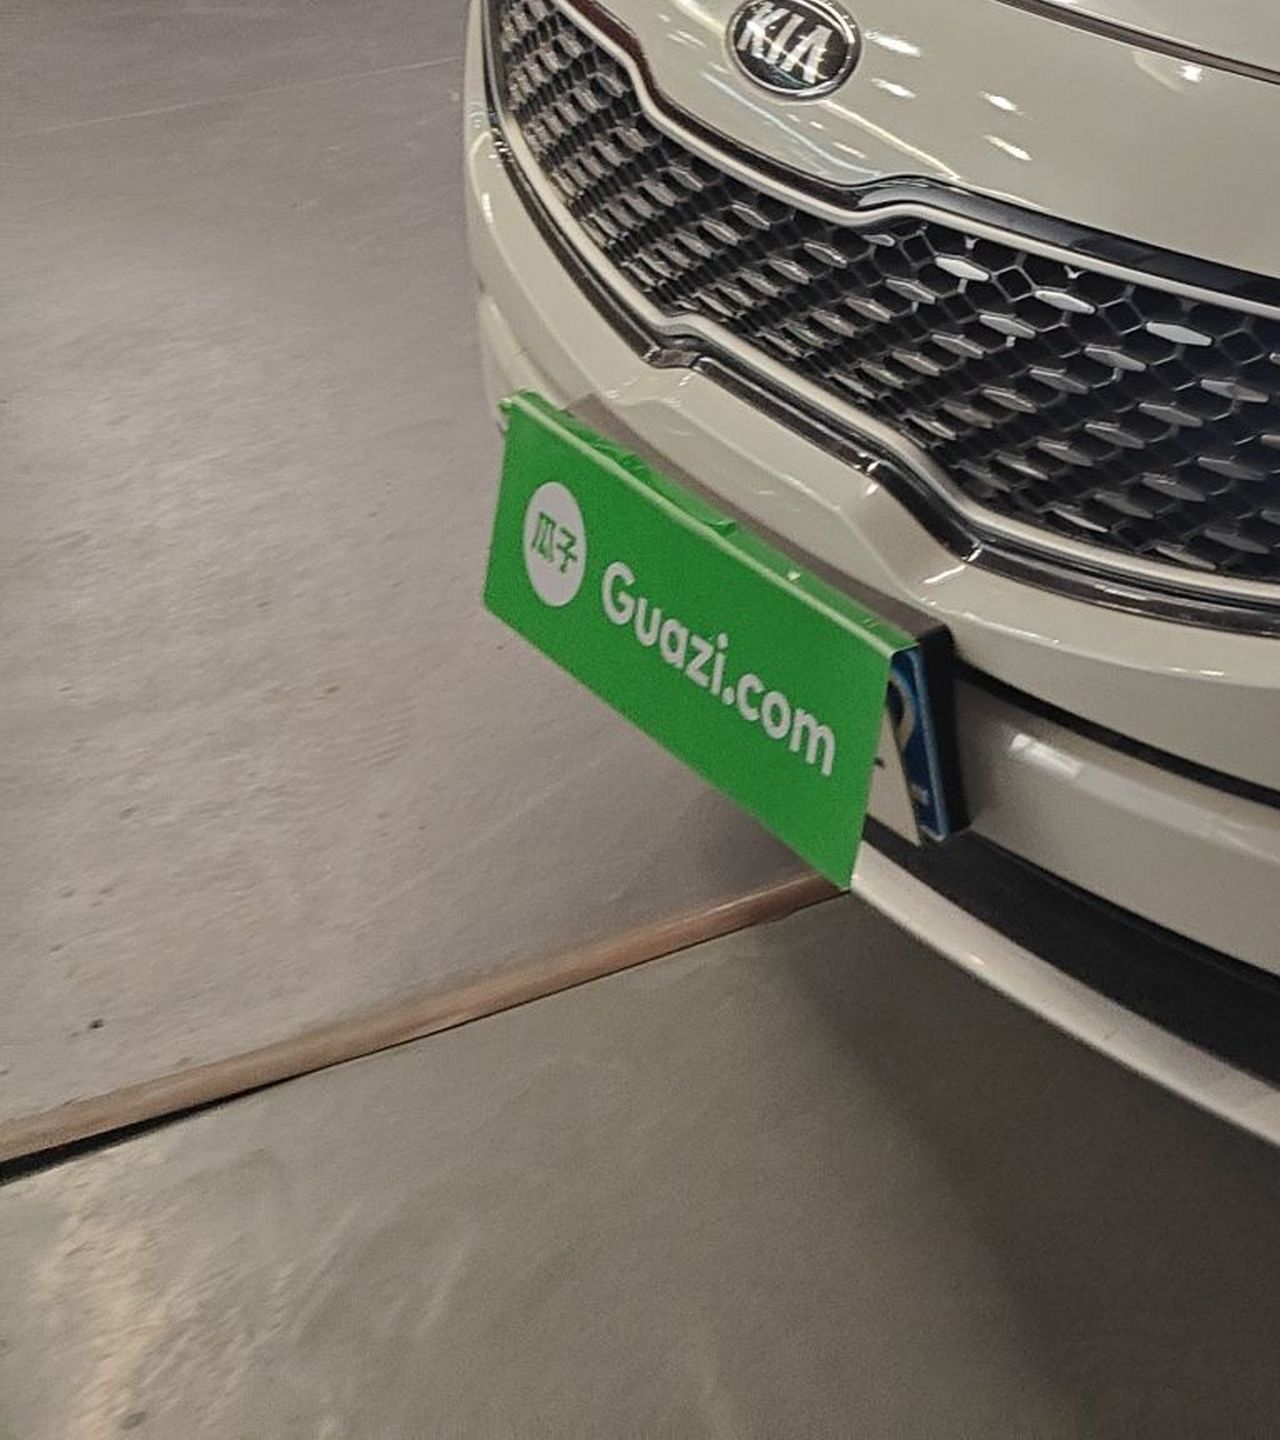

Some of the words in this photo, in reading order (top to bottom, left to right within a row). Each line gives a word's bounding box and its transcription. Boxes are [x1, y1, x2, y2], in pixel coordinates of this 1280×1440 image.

[736, 0, 833, 84] KIA
[531, 510, 580, 574] 瓜子
[601, 561, 837, 777] Guazi.com
